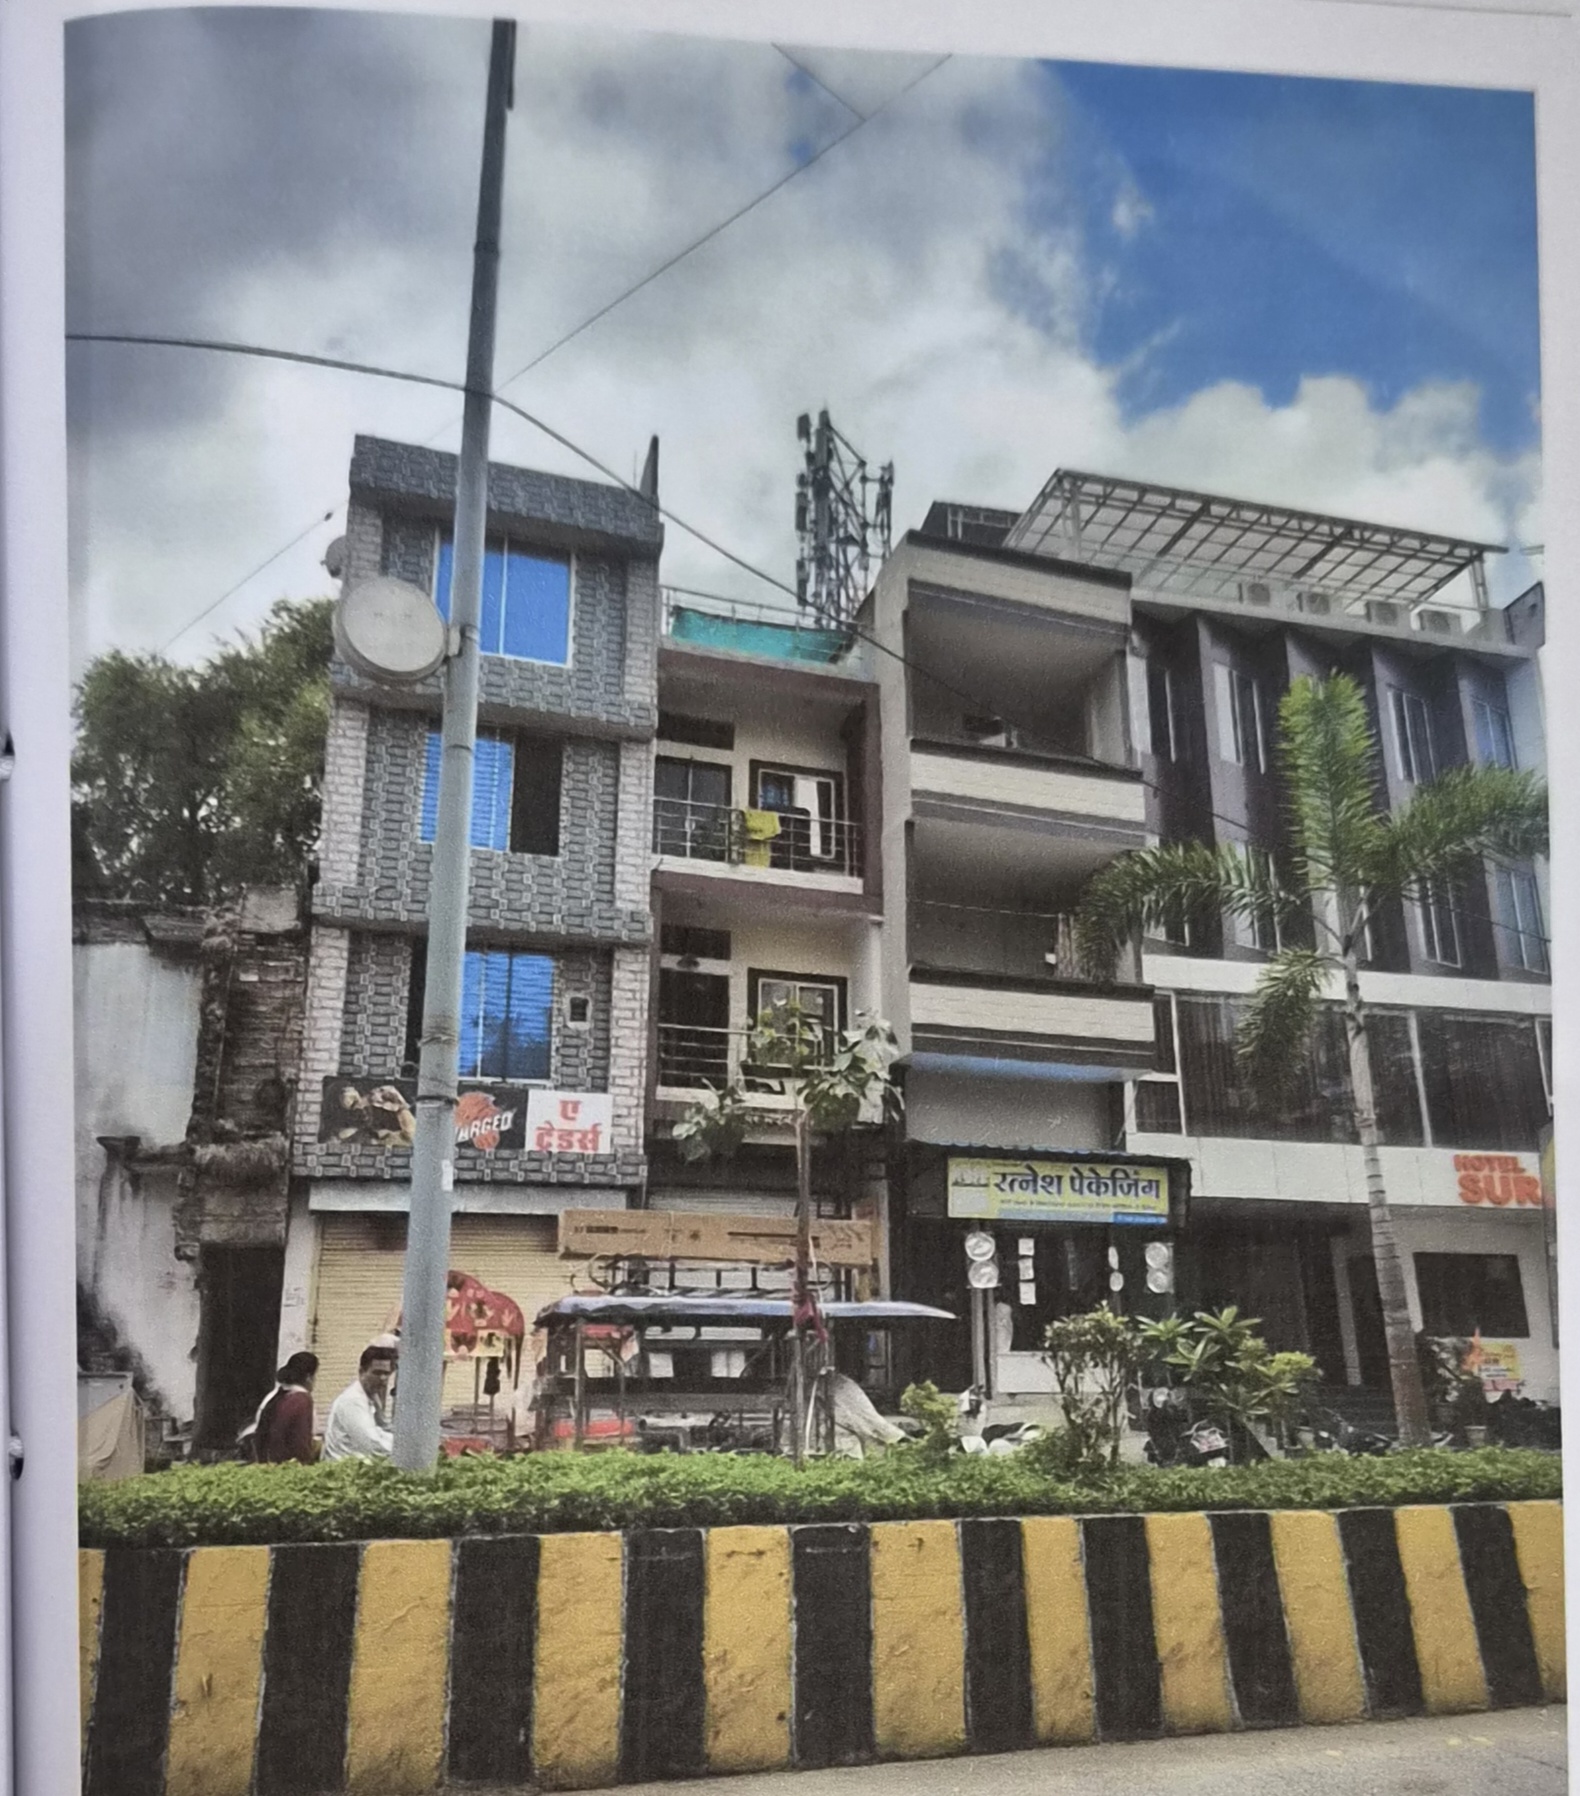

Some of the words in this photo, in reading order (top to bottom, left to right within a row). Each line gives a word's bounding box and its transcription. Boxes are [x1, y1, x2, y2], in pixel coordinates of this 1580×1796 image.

[558, 1099, 583, 1120] ए
[457, 1110, 516, 1142] ARGED
[1453, 1155, 1525, 1173] HOTEL
[992, 1164, 1063, 1196] रत्नेश
